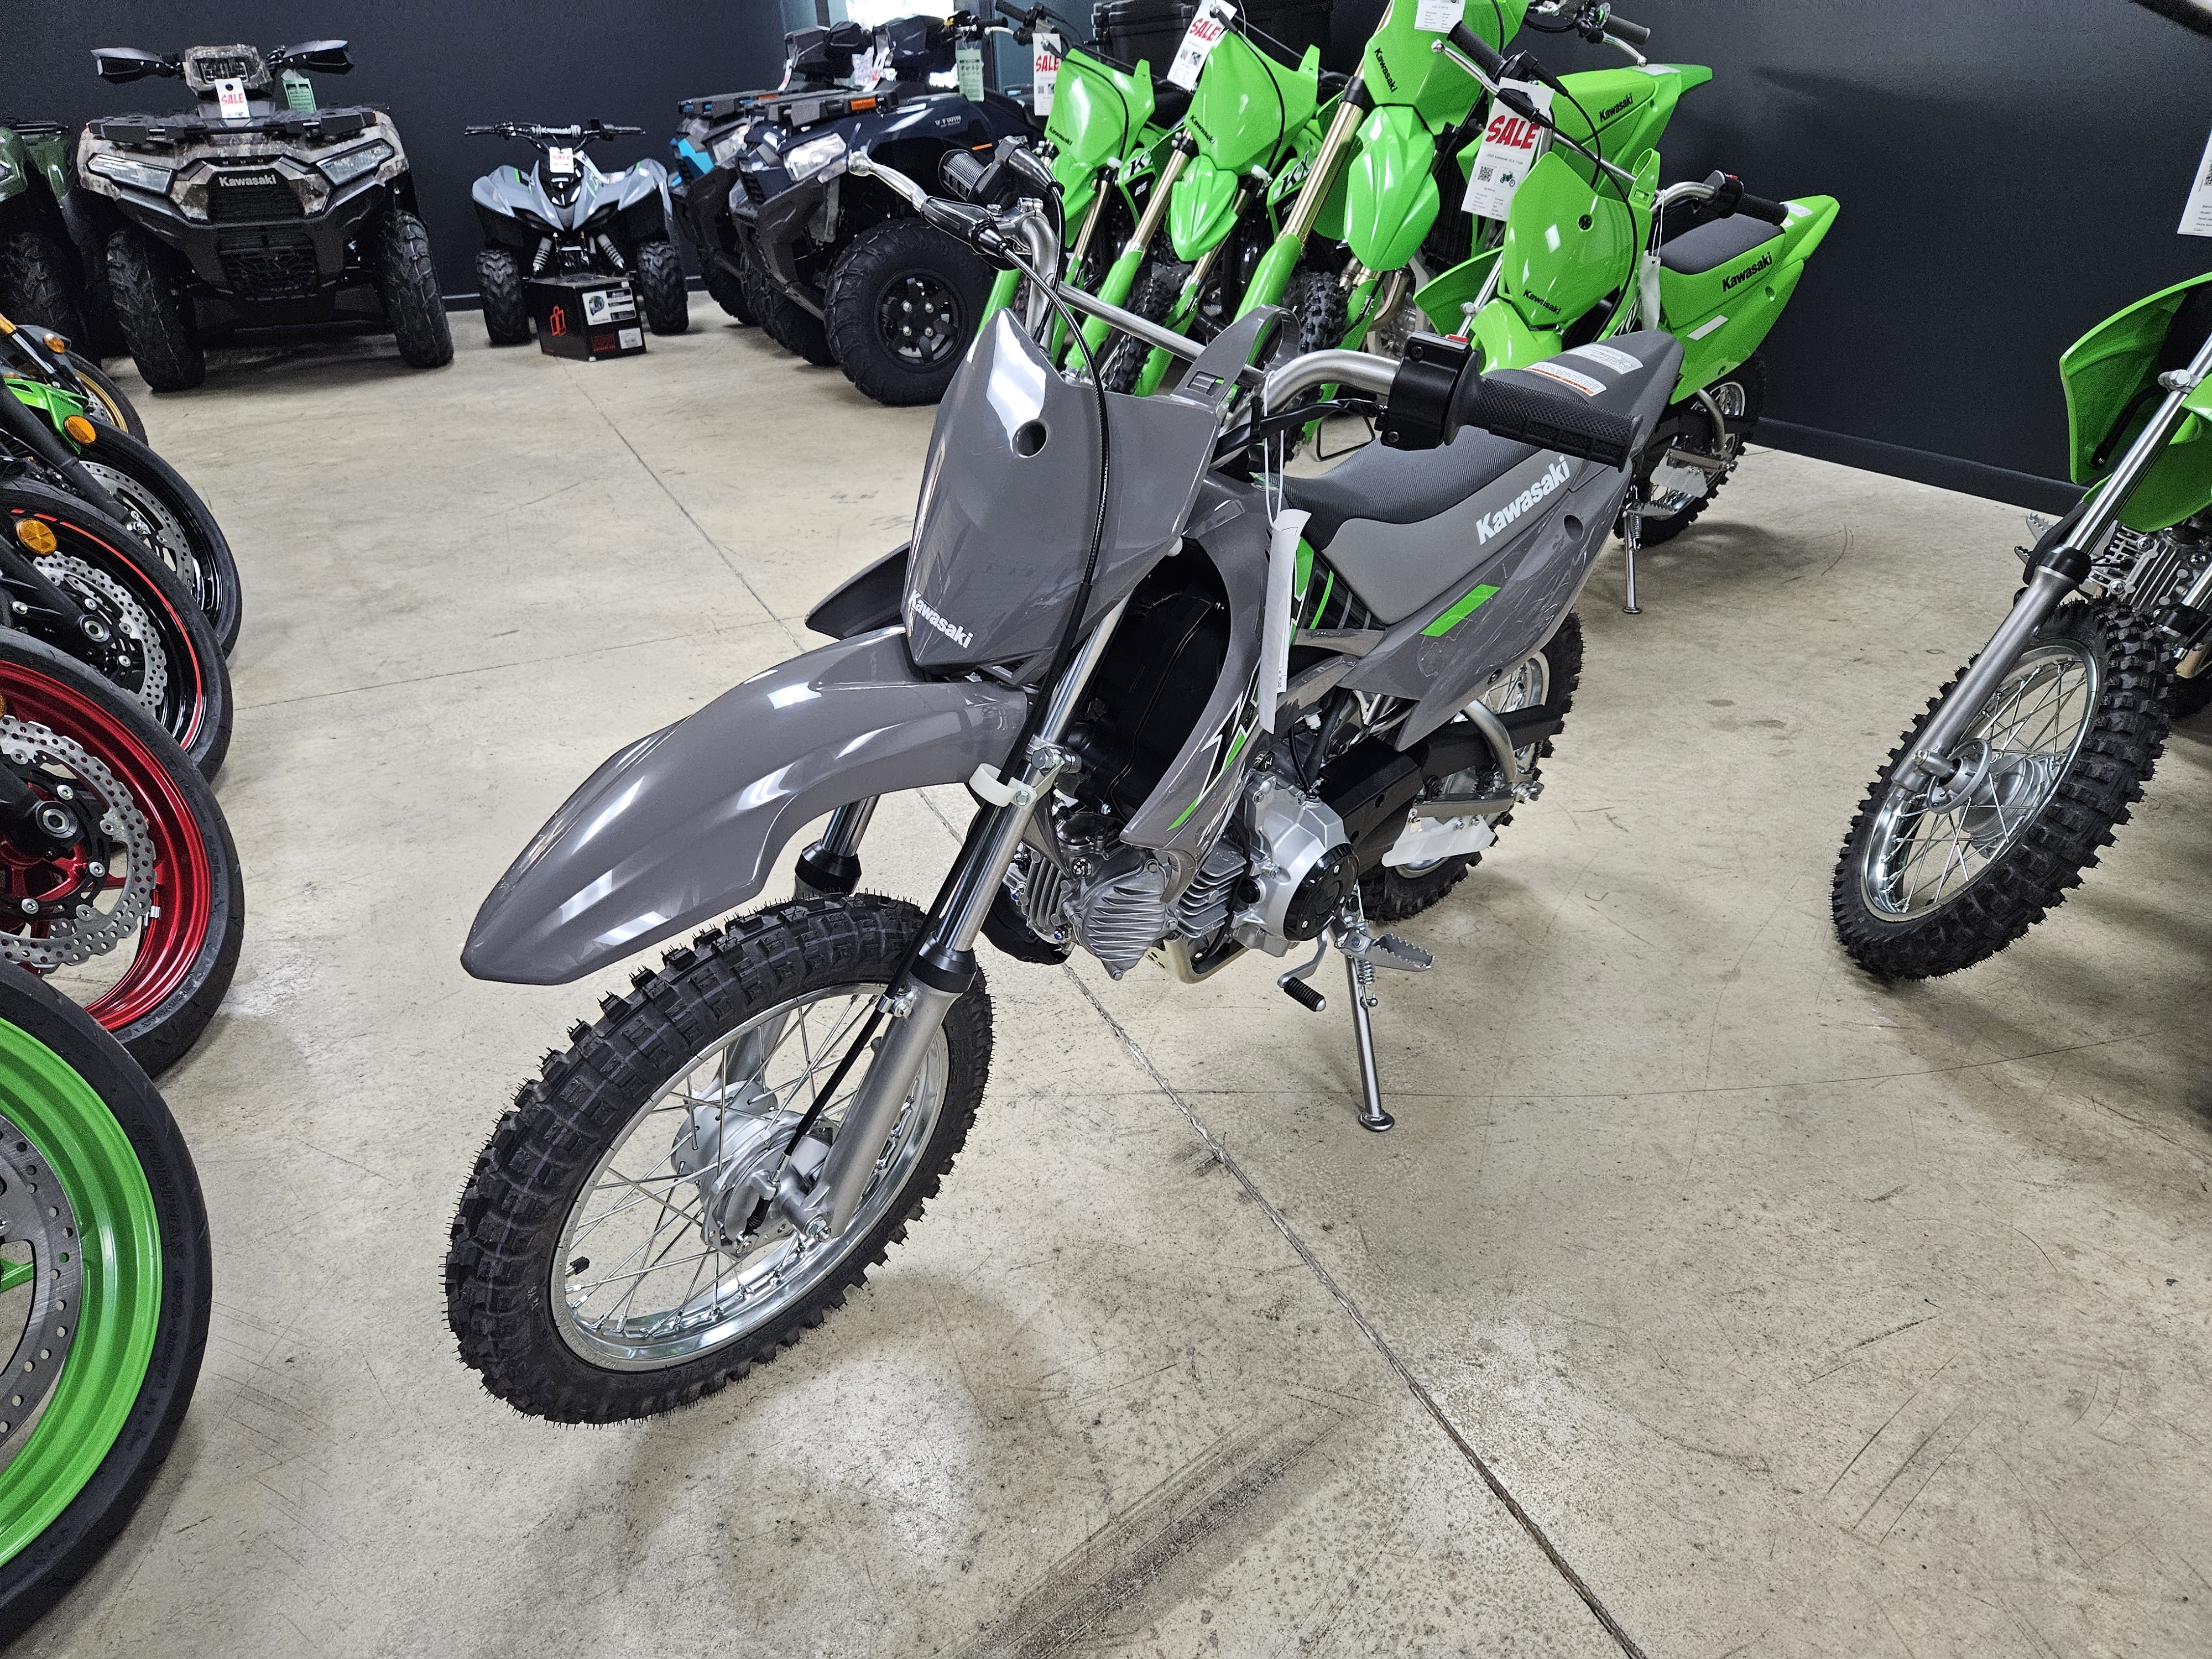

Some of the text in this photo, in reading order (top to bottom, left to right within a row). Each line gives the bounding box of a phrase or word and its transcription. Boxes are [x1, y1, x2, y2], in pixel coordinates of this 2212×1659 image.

[1190, 18, 1222, 41] SALE
[1036, 55, 1060, 72] SALE
[1374, 48, 1398, 92] Kawasaki
[222, 93, 243, 105] SALE
[1599, 92, 1633, 123] Kawasaki
[1048, 126, 1073, 146] Kawasaki
[1190, 114, 1217, 145] Kawasaki
[1485, 115, 1541, 149] SALE
[219, 174, 276, 187] Kawasaki
[1722, 251, 1772, 292] Kawasaki
[1523, 289, 1562, 315] Kawasaki
[1476, 455, 1570, 545] Kawasaki
[908, 589, 974, 649] Kawasaki
